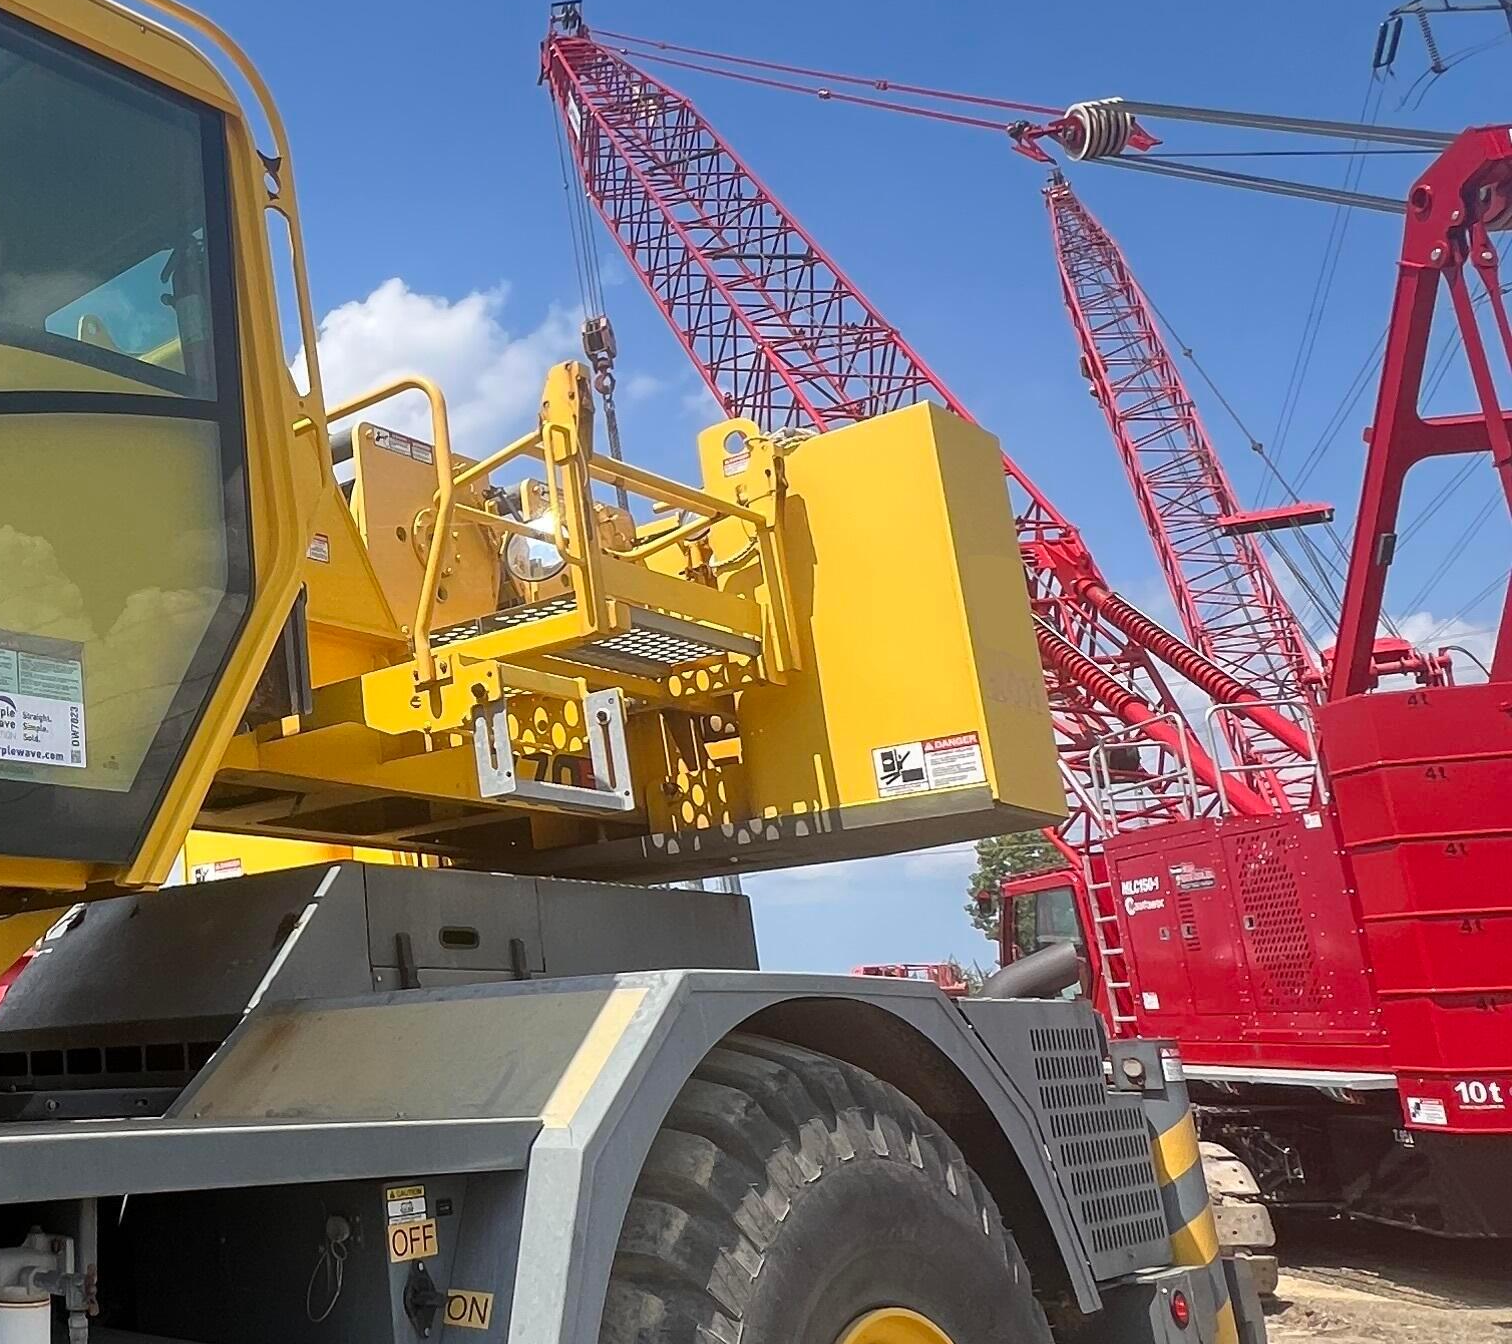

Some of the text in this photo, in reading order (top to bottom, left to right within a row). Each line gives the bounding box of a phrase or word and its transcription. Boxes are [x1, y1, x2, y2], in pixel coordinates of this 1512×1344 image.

[935, 735, 977, 750] DANGER
[392, 1224, 433, 1257] OFF
[447, 1294, 489, 1324] ON
